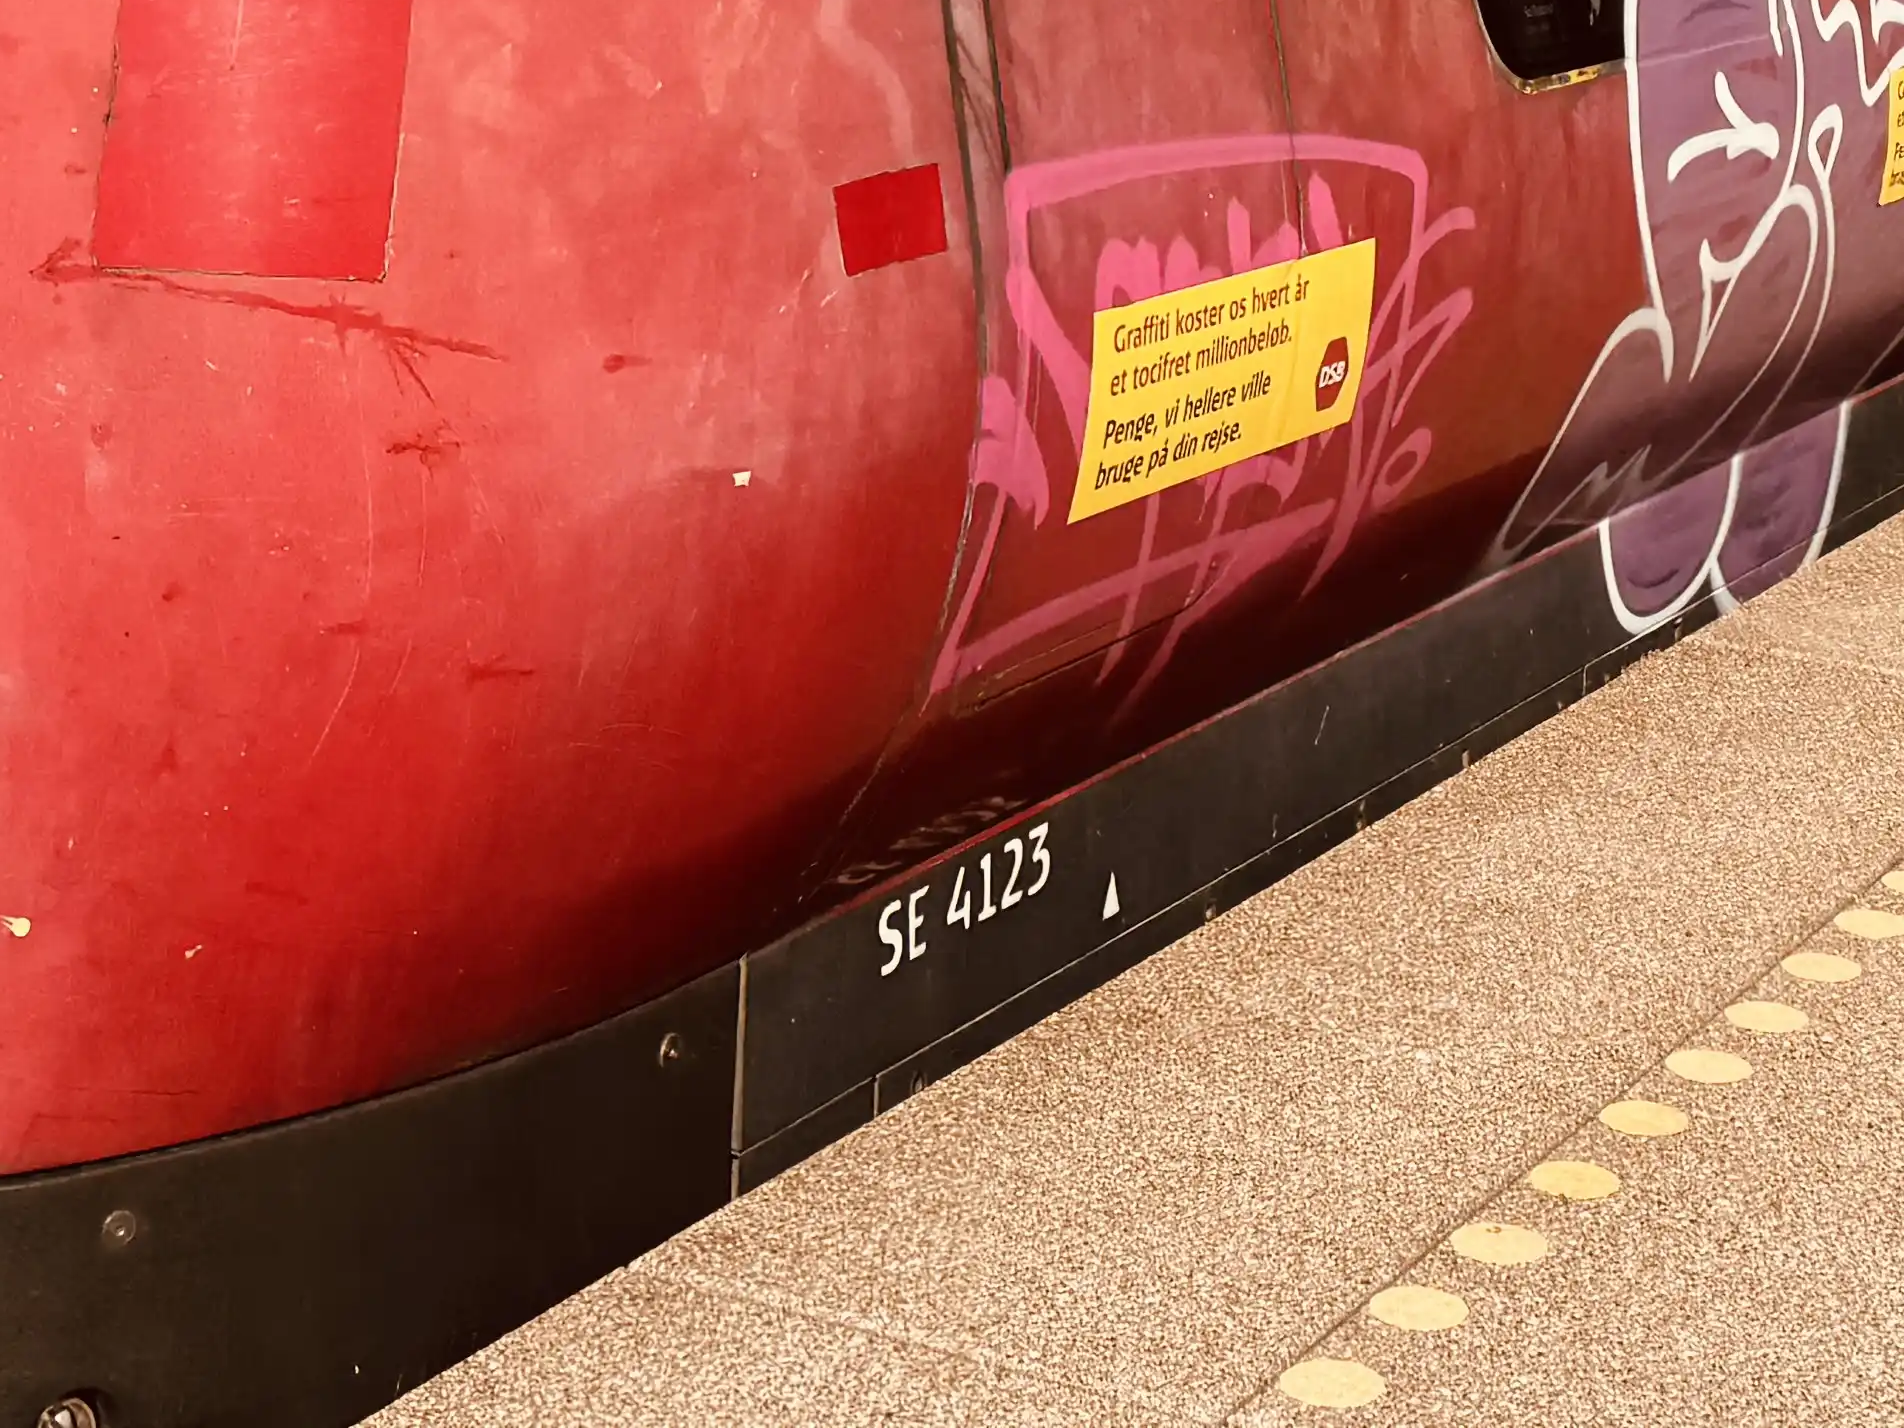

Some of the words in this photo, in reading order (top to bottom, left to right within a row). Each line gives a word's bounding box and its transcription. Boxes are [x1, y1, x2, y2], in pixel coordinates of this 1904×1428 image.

[1114, 312, 1170, 353] Graffiti
[1175, 302, 1225, 336] koster
[1229, 298, 1246, 320] os
[1252, 283, 1289, 314] hvert
[1294, 274, 1309, 301] år
[1111, 368, 1128, 396] et
[1133, 352, 1190, 387] tocifret
[1196, 318, 1292, 371] millionbeløb.
[1319, 361, 1345, 389] DSB
[1103, 413, 1159, 449] Penge,
[1165, 399, 1178, 428] vi
[1183, 386, 1236, 423] hellere
[1241, 370, 1271, 402] ville
[1095, 456, 1144, 490] bruge
[1146, 439, 1168, 478] på
[1173, 434, 1197, 461] din
[1202, 421, 1242, 454] rejse.
[878, 885, 930, 976] SE
[947, 821, 1051, 930] 4123
